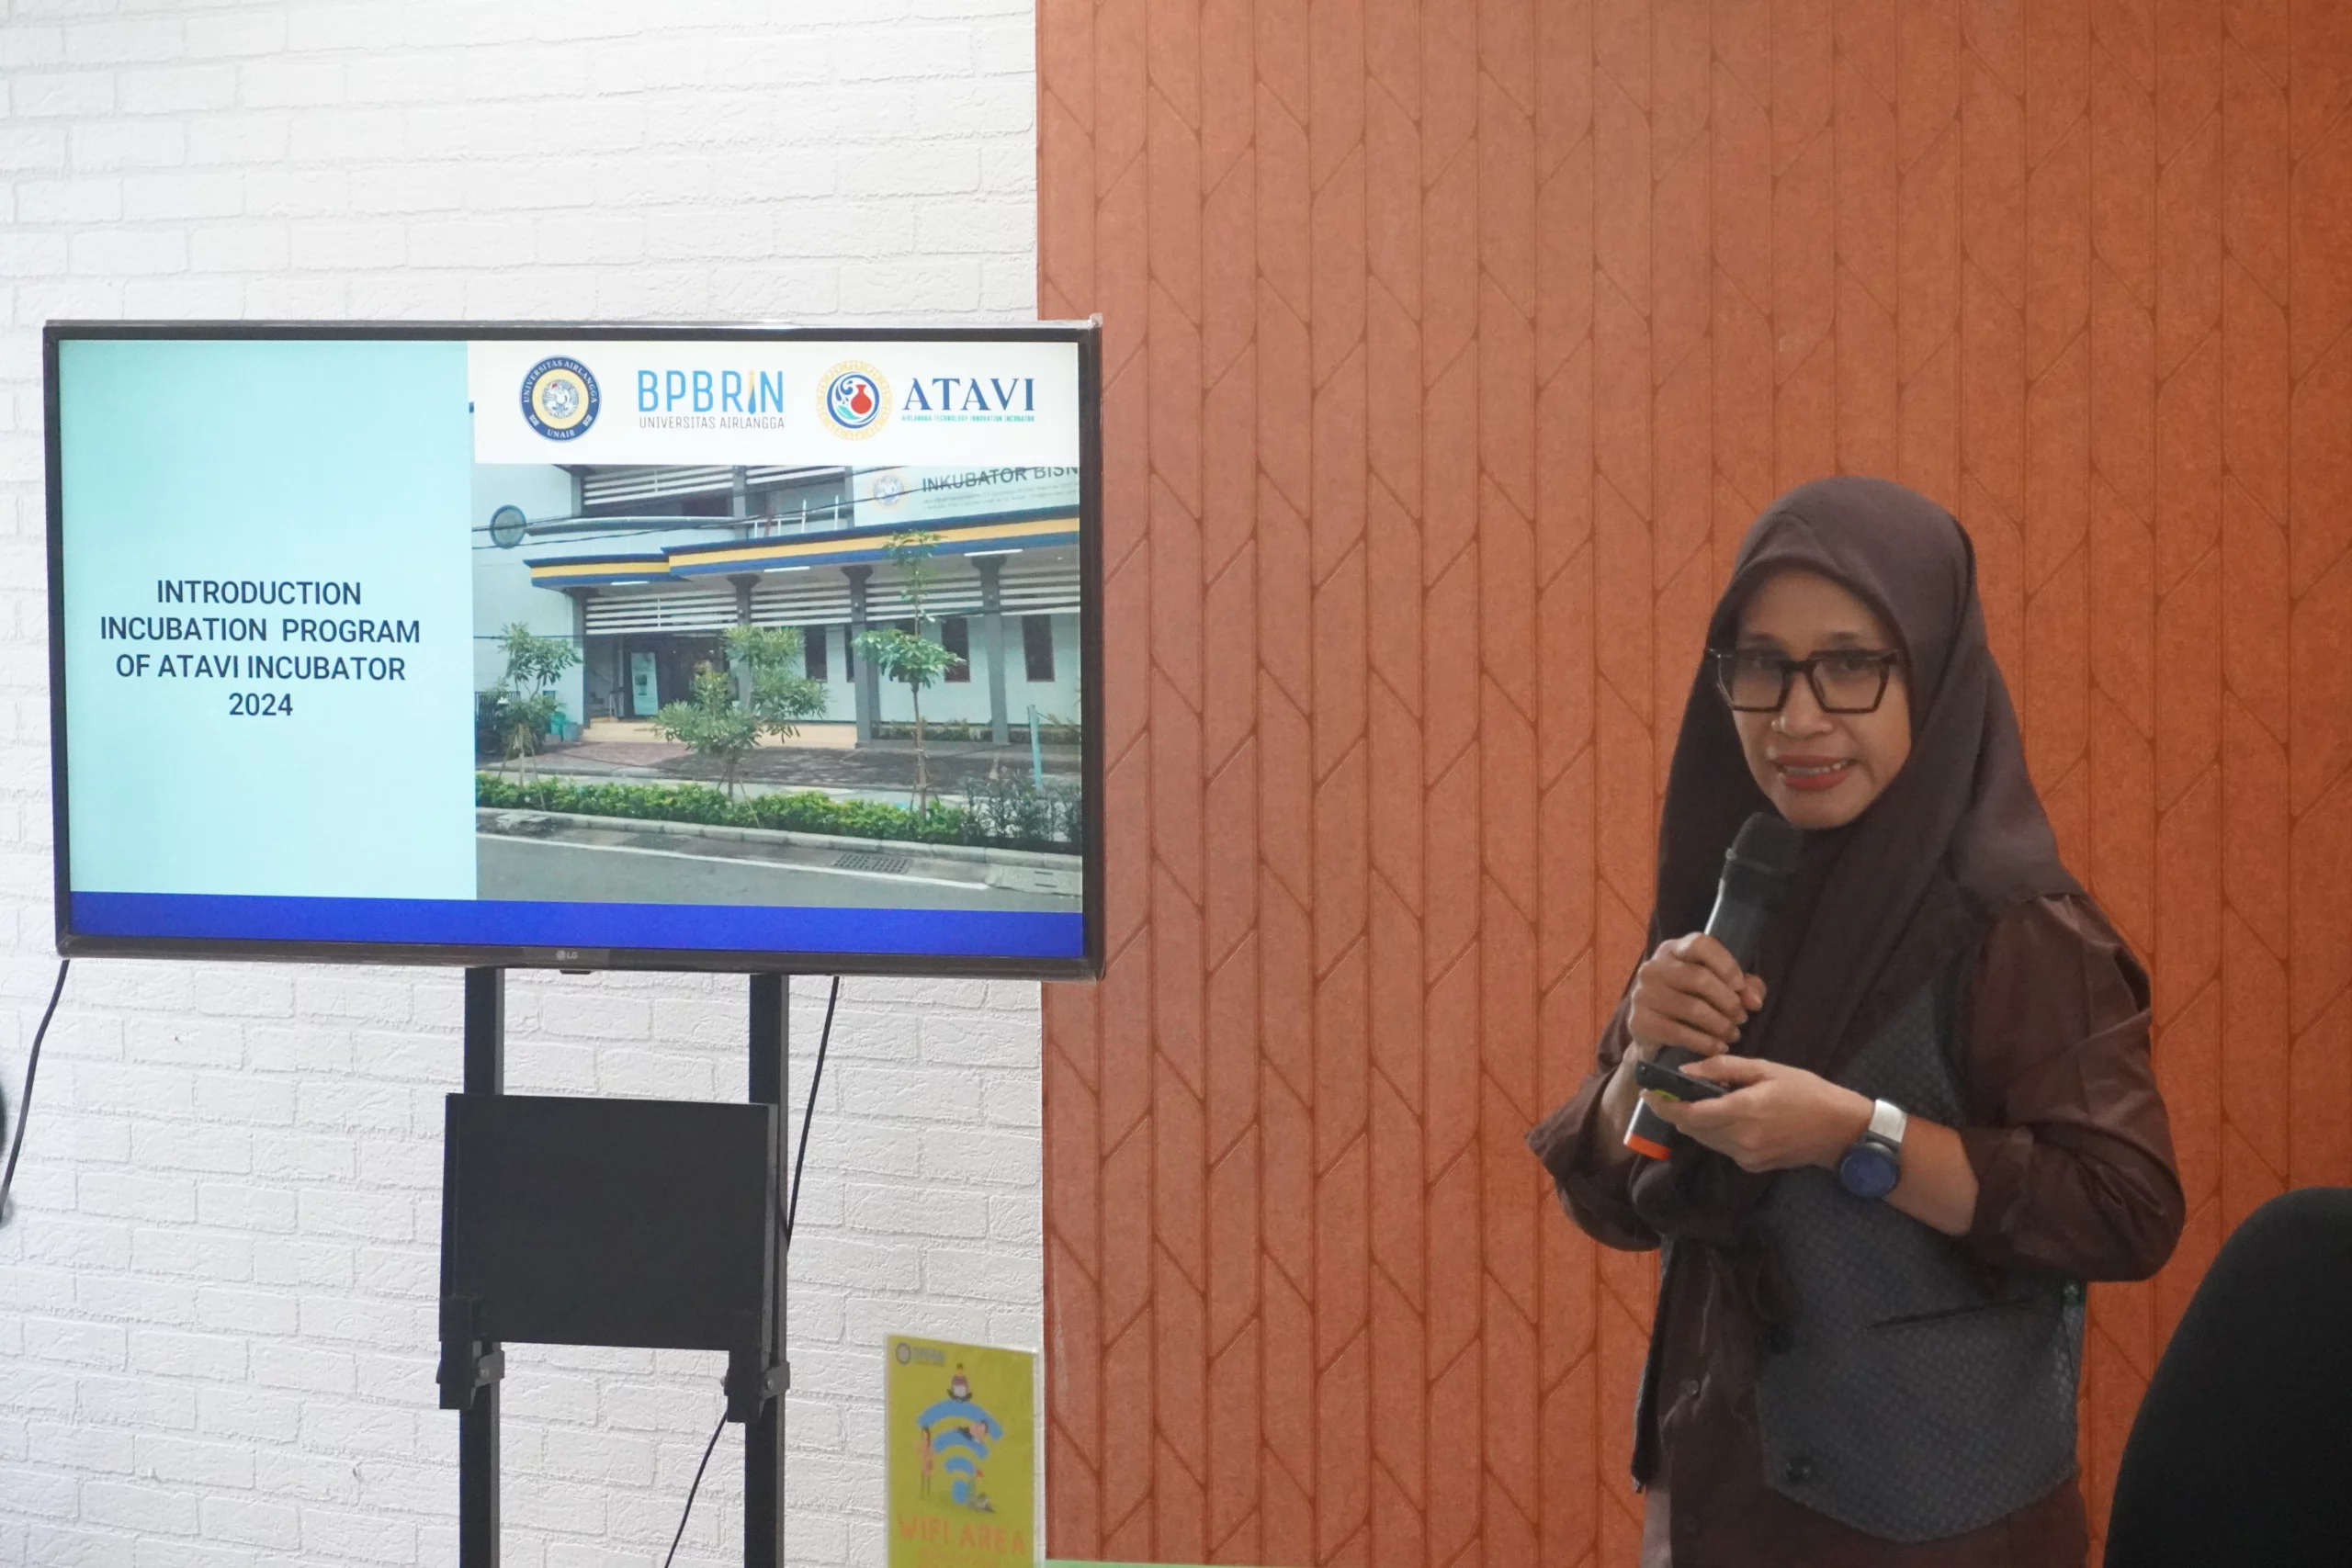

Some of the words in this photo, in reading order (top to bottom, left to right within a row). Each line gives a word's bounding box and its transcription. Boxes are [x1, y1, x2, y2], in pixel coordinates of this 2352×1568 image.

[523, 359, 563, 403] UNIVERSITAS
[563, 360, 598, 404] AIRLANGGA
[638, 369, 784, 414] BPBRIN
[901, 378, 1035, 412] ATAVI
[547, 428, 576, 439] UNAIR
[639, 416, 716, 430] UNIVERSITAS
[719, 416, 785, 430] AIRLANGGA
[922, 467, 1027, 493] INKUBATOR
[156, 580, 362, 605] INTRODUCTION
[100, 616, 267, 642] INCUBATION
[282, 618, 421, 643] PROGRAM
[116, 653, 151, 678] OF
[157, 655, 239, 679] ATAVI
[247, 656, 406, 681] INCUBATOR
[229, 692, 293, 716] 2024
[566, 951, 578, 960] LG
[897, 1512, 950, 1545] WIFI
[958, 1522, 1026, 1555] AREA
